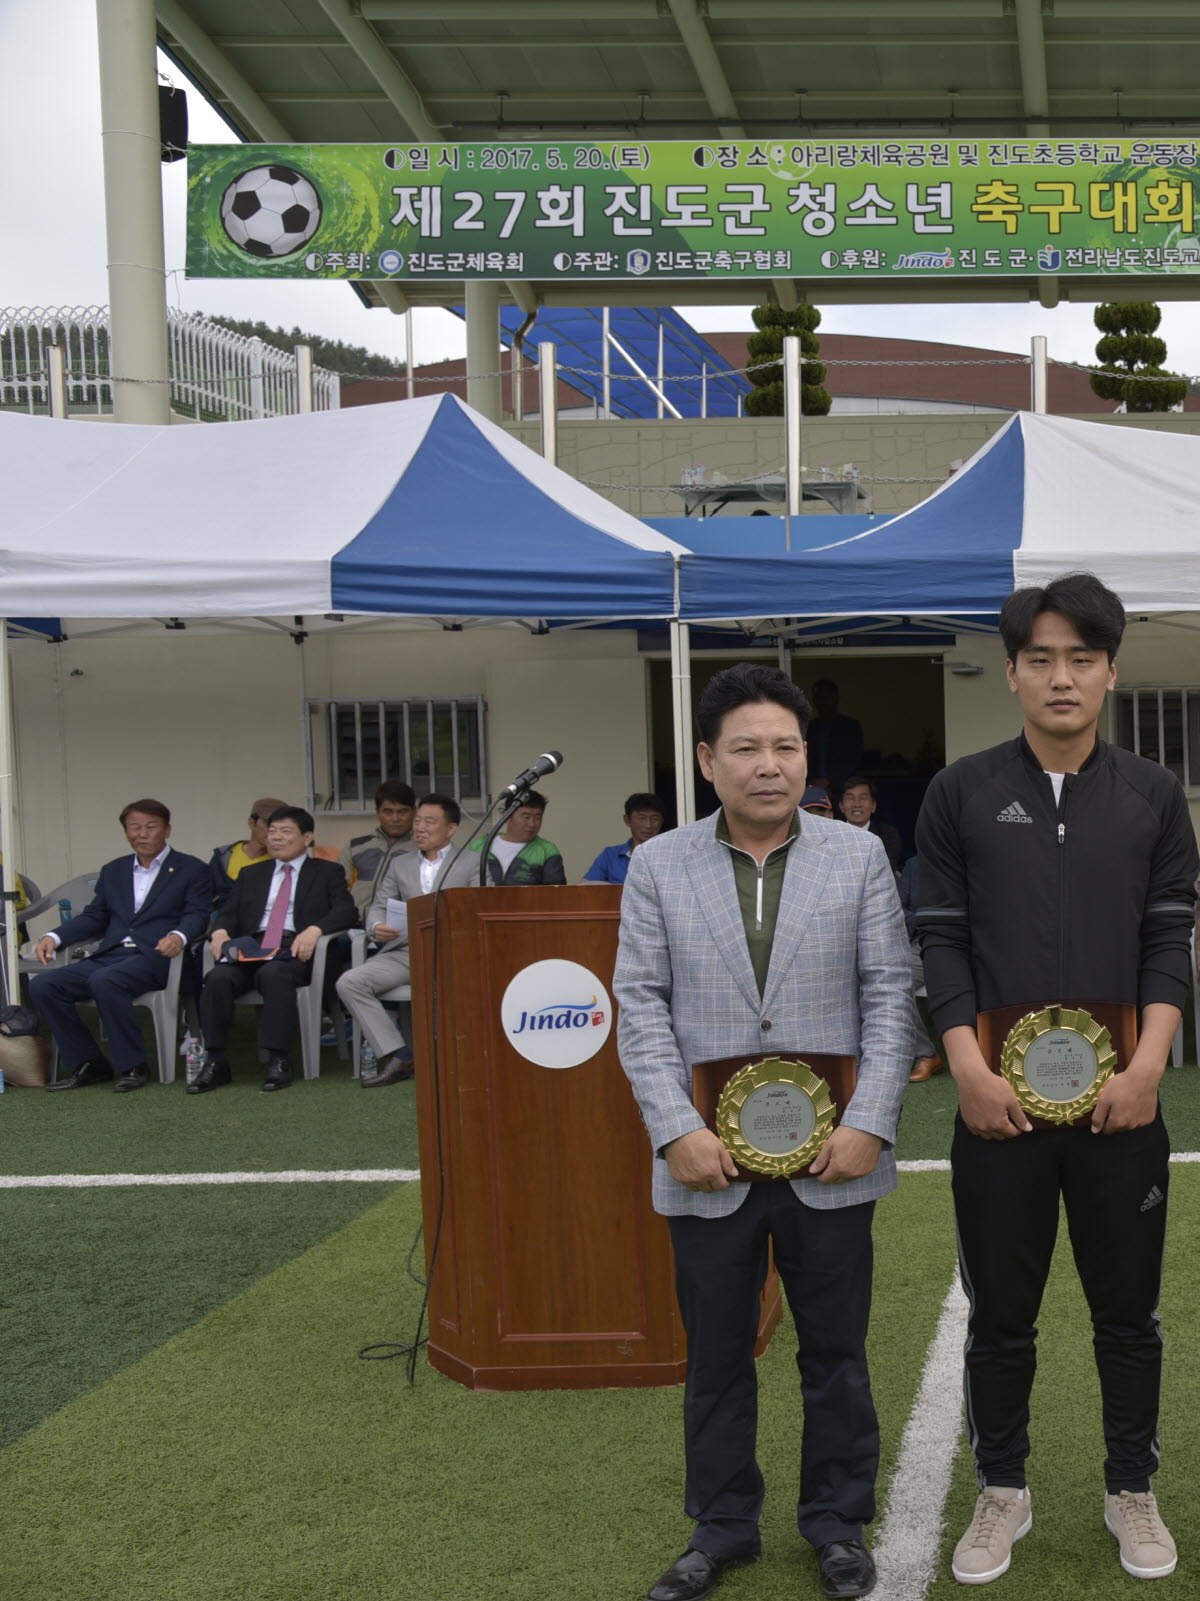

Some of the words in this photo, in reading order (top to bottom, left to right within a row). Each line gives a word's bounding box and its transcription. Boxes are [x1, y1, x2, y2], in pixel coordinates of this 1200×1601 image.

[481, 149, 539, 169] 2017.
[546, 148, 568, 169] 5.
[791, 143, 950, 168] 아리랑체육공원
[958, 143, 979, 167] 및
[987, 142, 1123, 167] 진도초등학교
[1130, 142, 1198, 167] 운동장
[602, 183, 772, 237] 진도군
[787, 181, 955, 237] 청소년
[970, 179, 1196, 235] 축구대회
[407, 250, 525, 273] 진도군체육회
[655, 249, 793, 271] 진도군축구협회
[892, 254, 944, 270] Jindo
[997, 814, 1033, 824] adidas
[512, 1009, 589, 1034] Jindo
